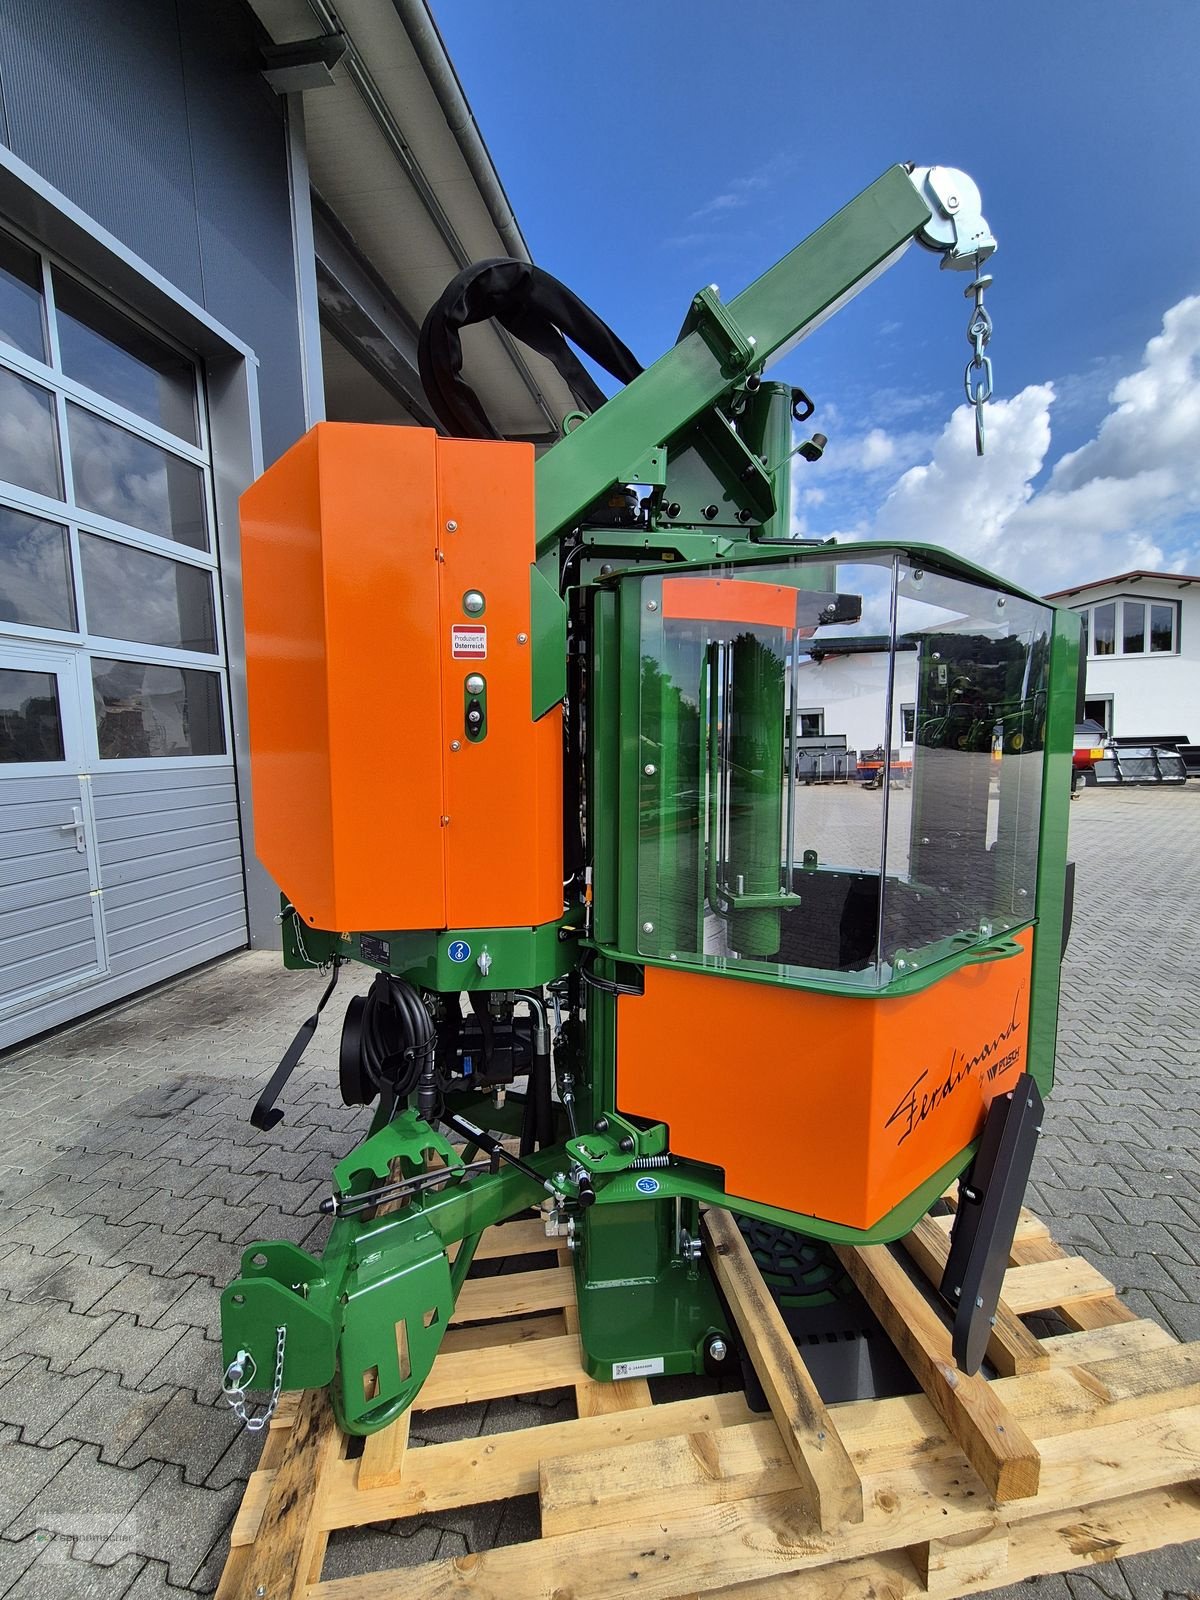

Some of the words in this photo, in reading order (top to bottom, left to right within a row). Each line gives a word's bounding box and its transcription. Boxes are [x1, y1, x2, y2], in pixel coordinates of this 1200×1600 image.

[454, 634, 479, 642] Produziert
[454, 642, 485, 650] Österreich
[885, 989, 1021, 1147] Ferdinand
